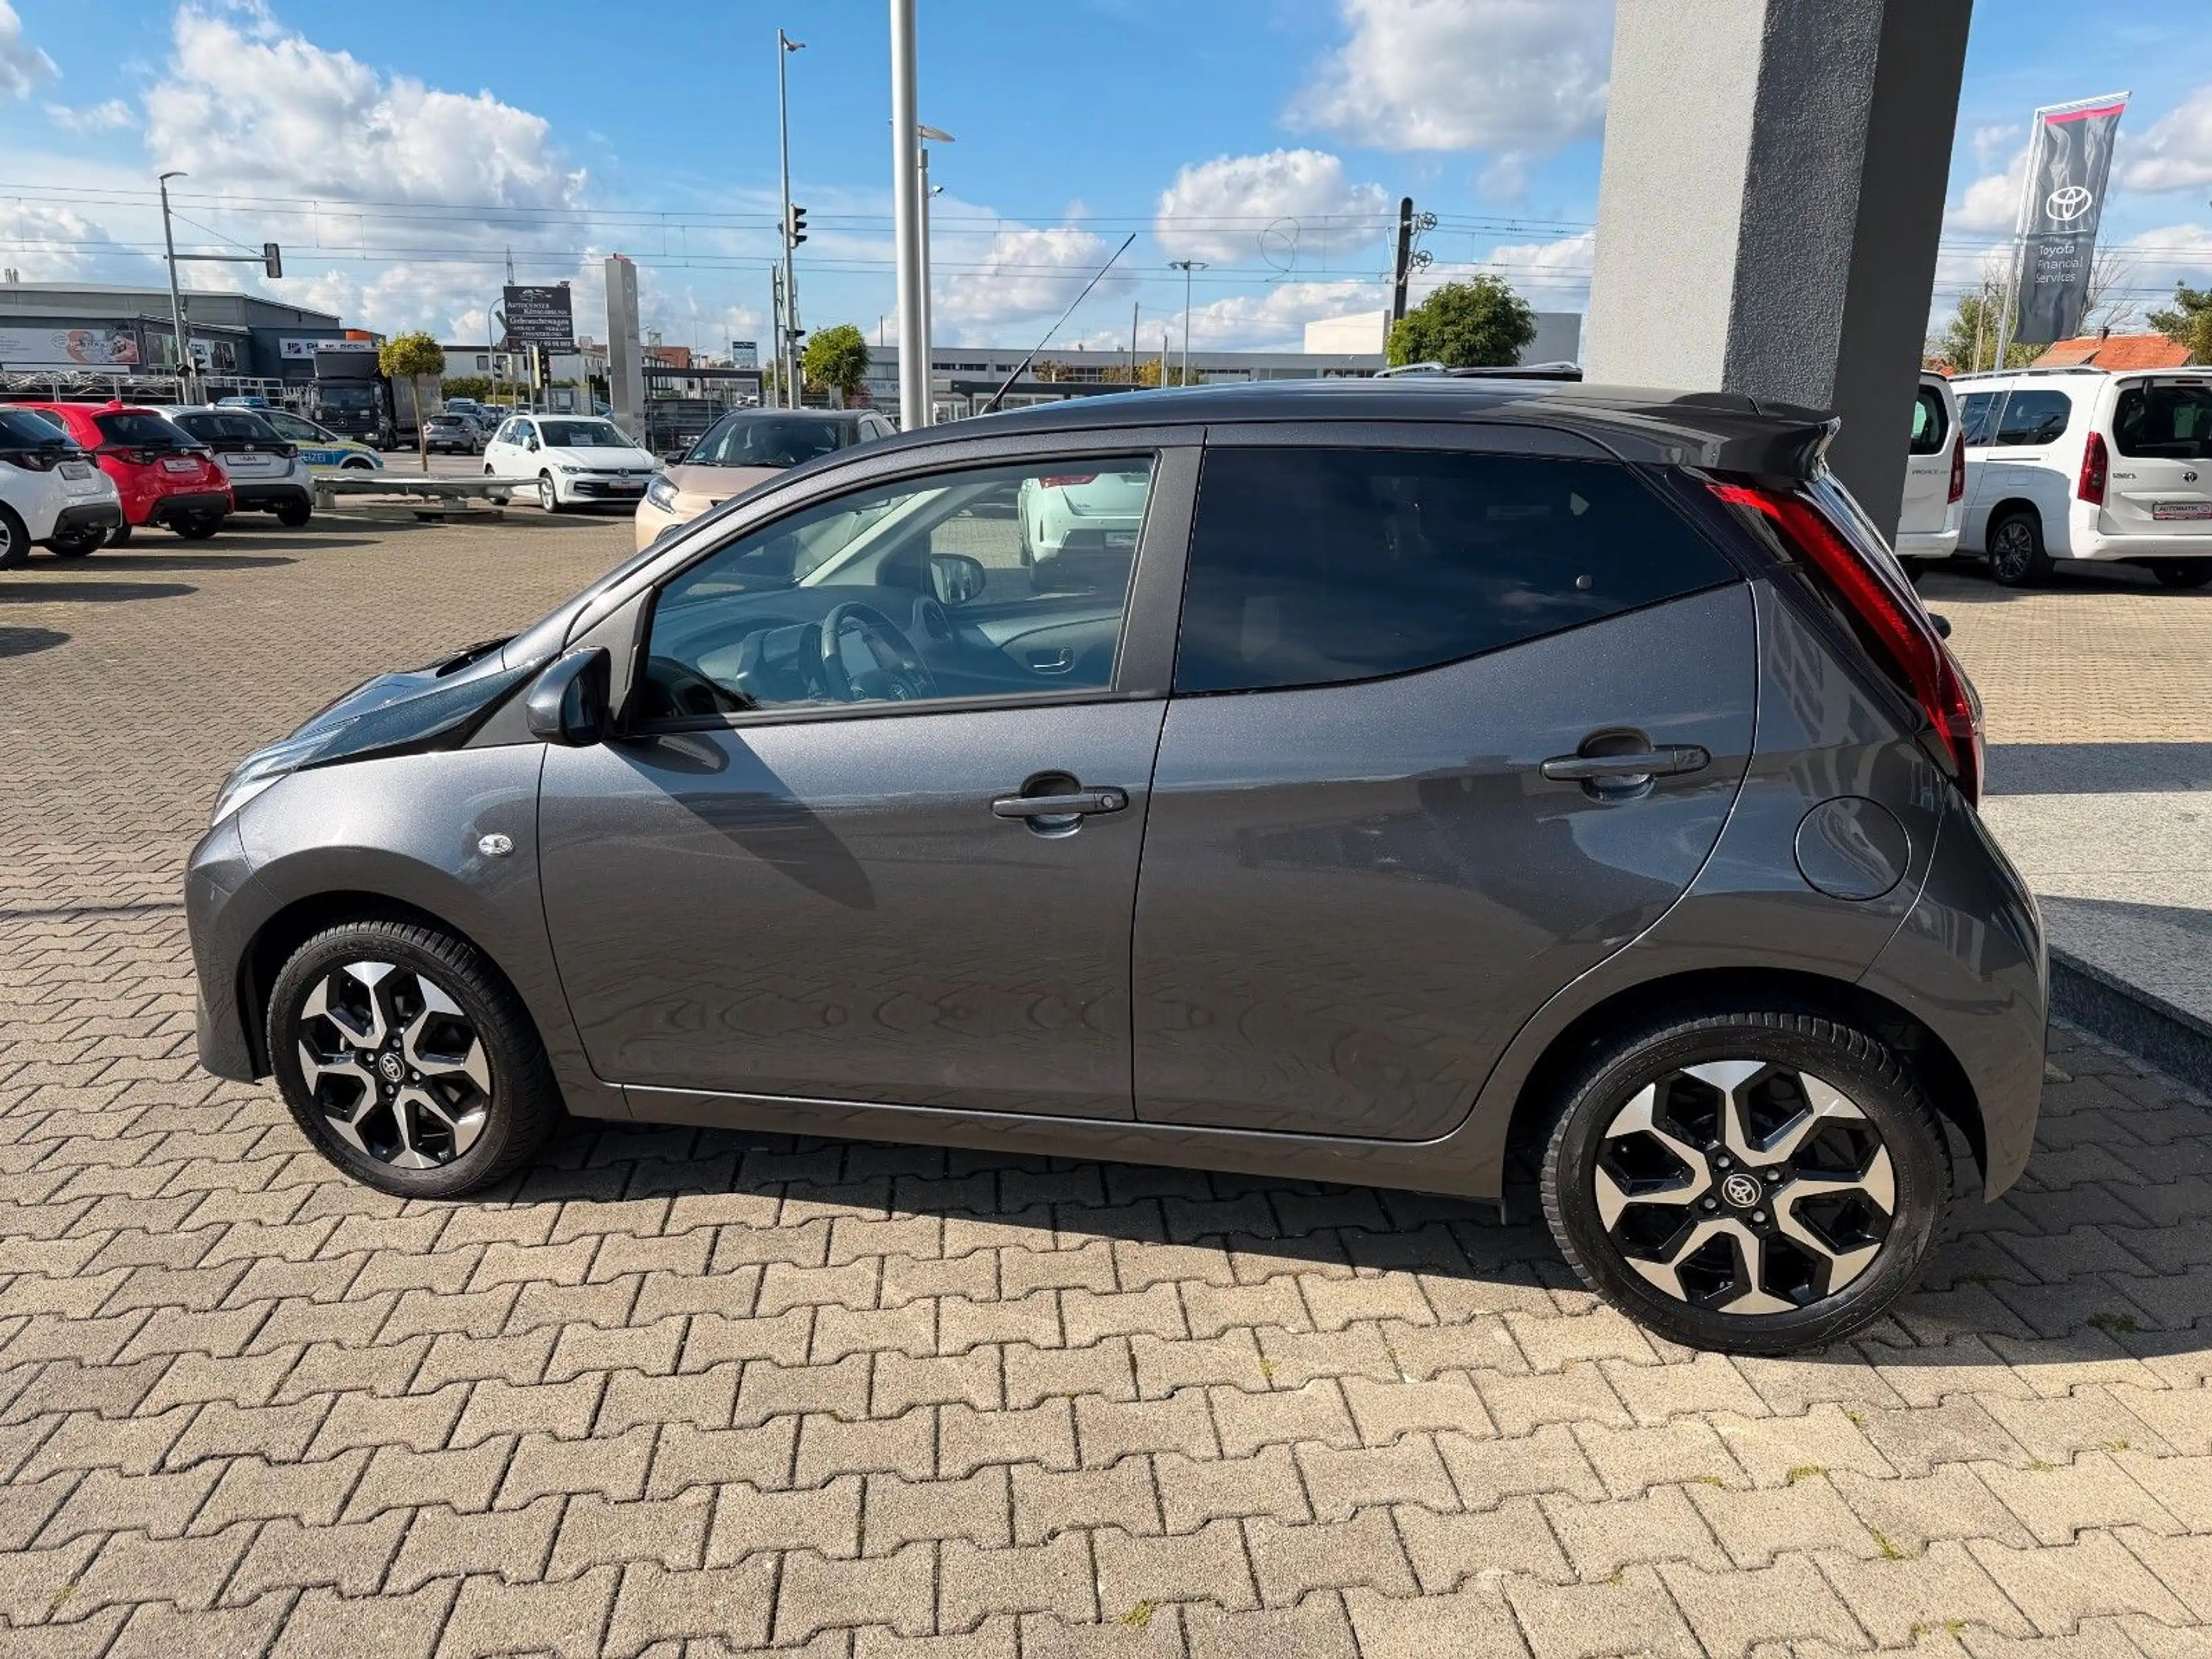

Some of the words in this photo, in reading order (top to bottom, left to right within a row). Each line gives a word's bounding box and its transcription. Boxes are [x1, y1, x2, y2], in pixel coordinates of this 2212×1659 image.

[2039, 244, 2074, 259] Toyota
[2038, 256, 2083, 269] Financial
[2036, 272, 2076, 283] Services
[510, 317, 569, 326] Gebrauchtwagen
[2158, 504, 2198, 512] AUTOMATIK
